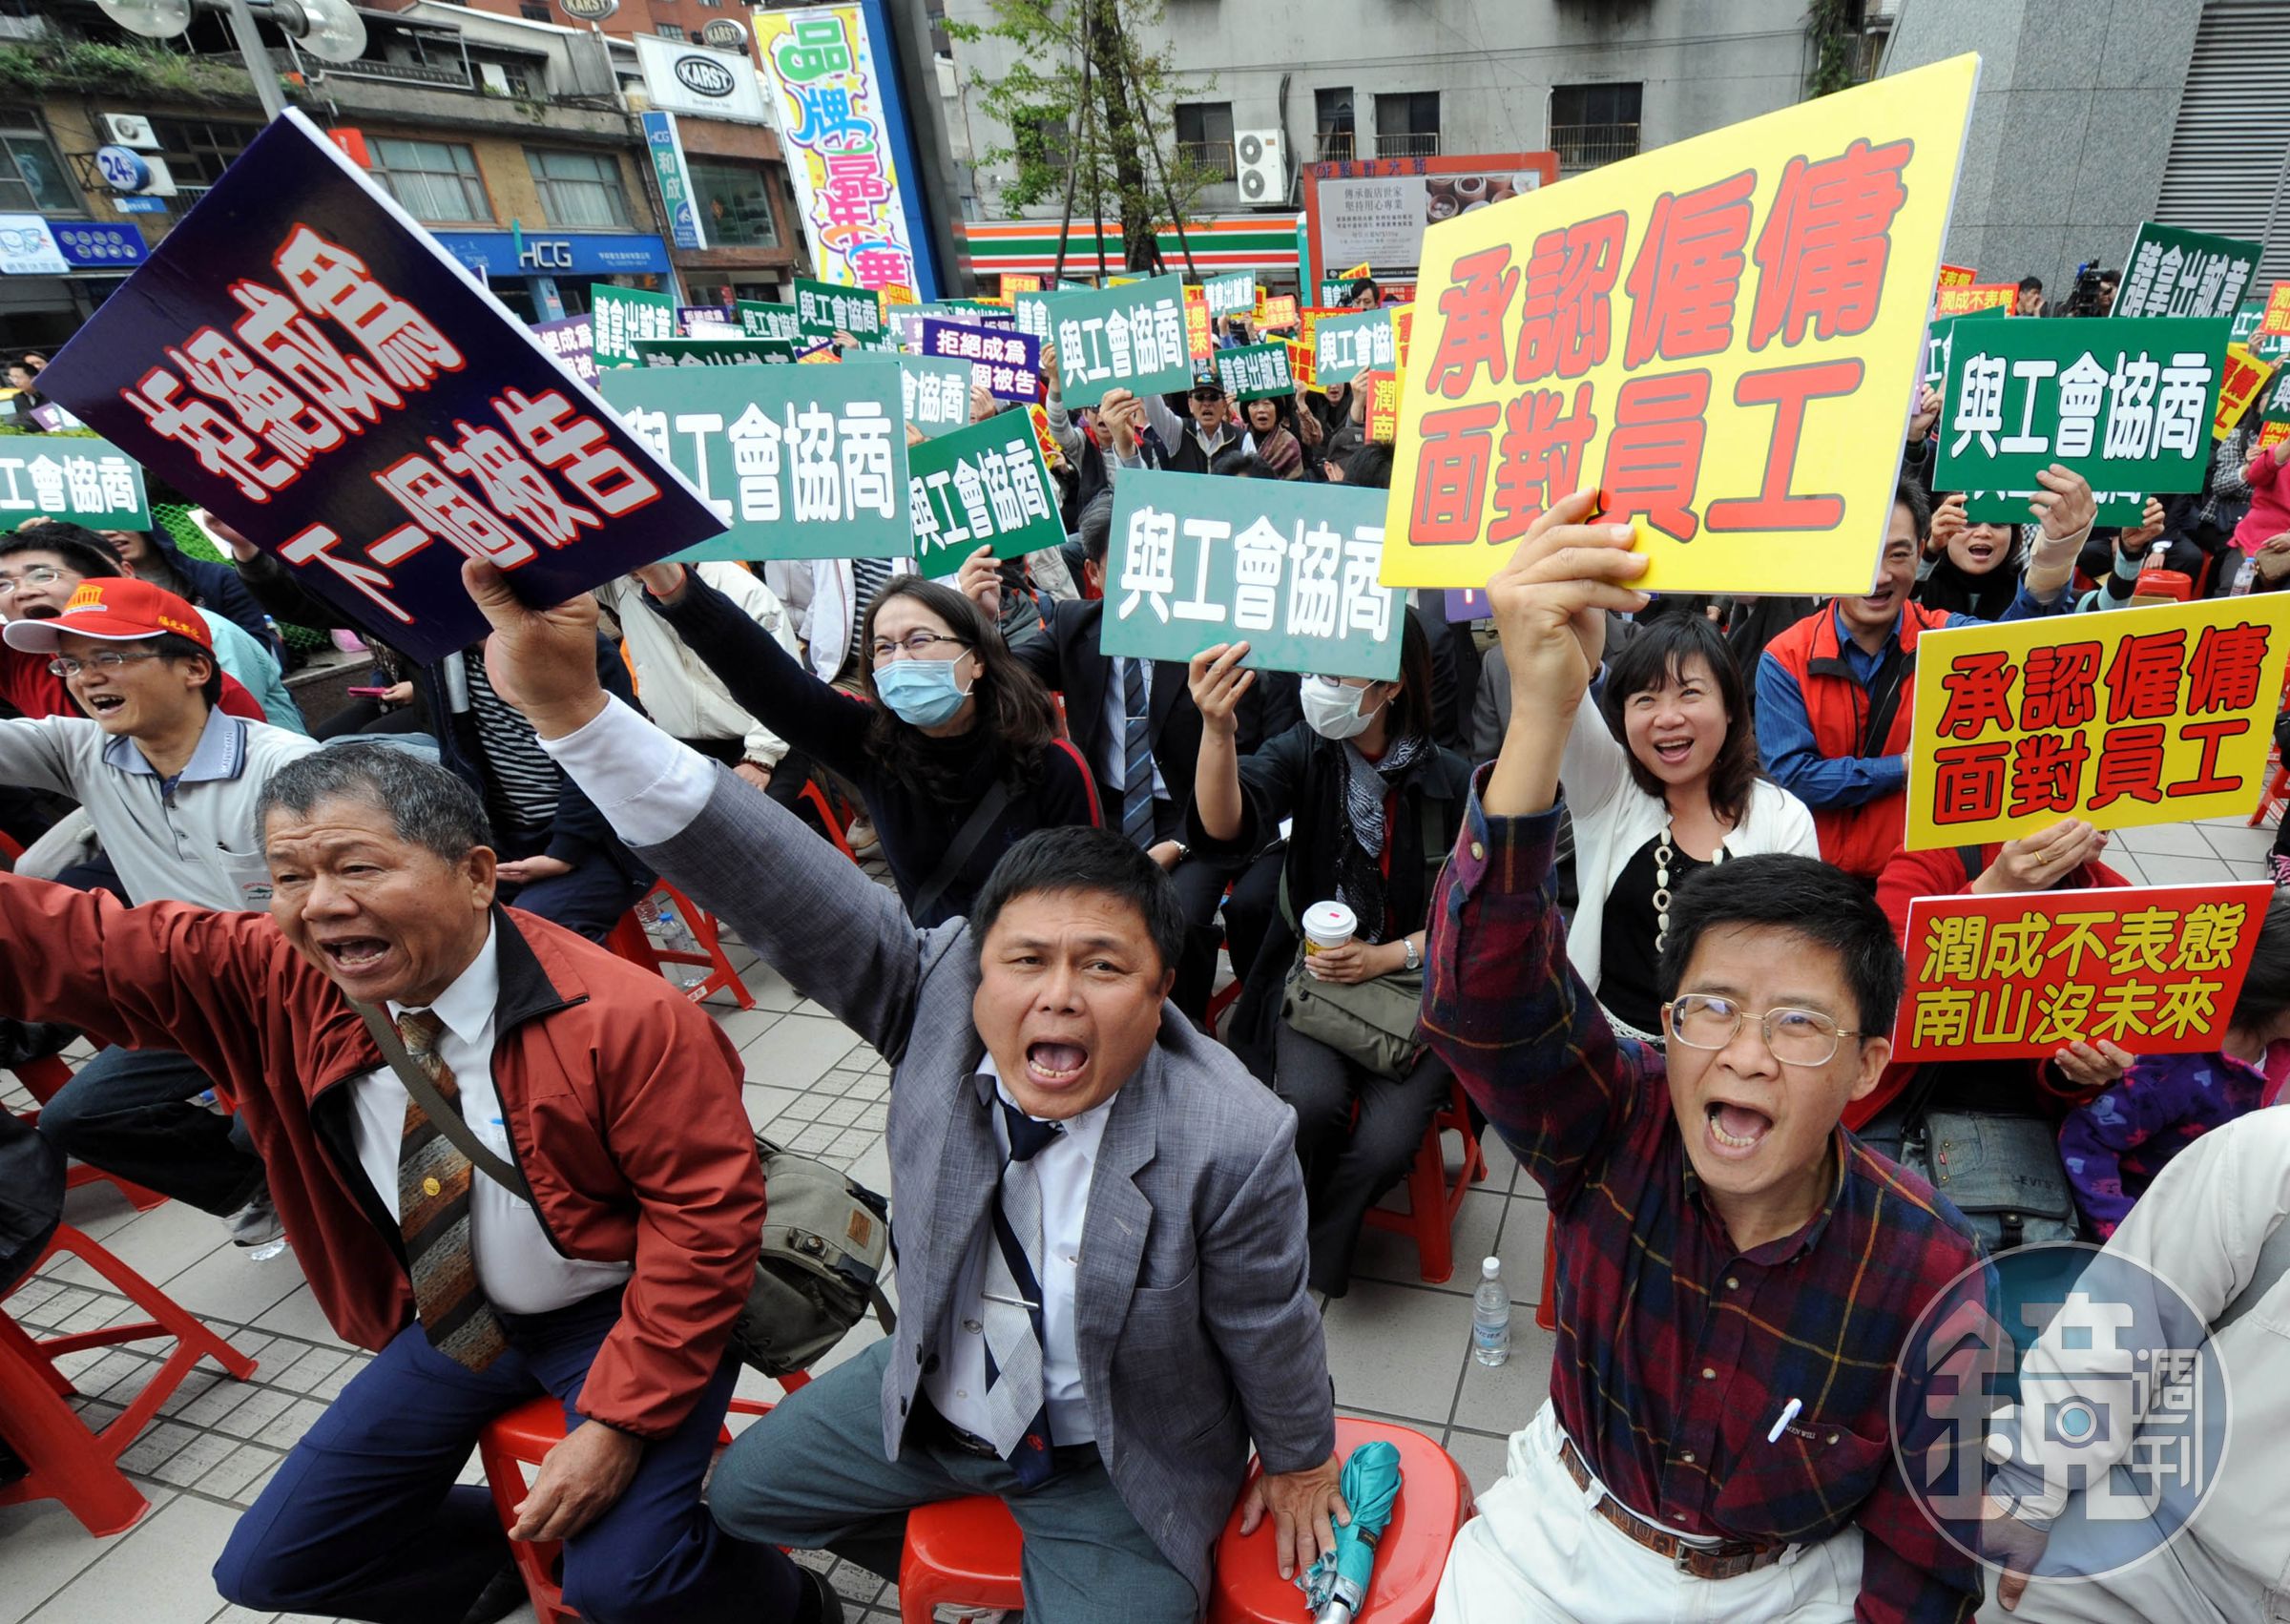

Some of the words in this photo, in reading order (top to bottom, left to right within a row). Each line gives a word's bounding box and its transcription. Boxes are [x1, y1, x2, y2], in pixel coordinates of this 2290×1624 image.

[680, 63, 730, 93] KARST
[706, 27, 738, 44] KARST
[650, 131, 670, 143] HCG
[657, 151, 682, 199] 和成
[778, 19, 909, 290] 品牌嘉年華
[519, 241, 572, 268] HCG
[1426, 138, 1914, 398] 承認僱傭
[800, 290, 878, 334] 與工會協商
[1059, 299, 1183, 387] 與工會協商
[1219, 349, 1291, 394] 請拿出誠意
[1950, 351, 2213, 460] 與工會協商
[1409, 359, 1864, 544] 面對員工
[278, 386, 662, 623] 下一個被告
[910, 438, 1050, 556] 與工會協商
[1117, 506, 1393, 642] 與工會協商
[1936, 621, 2271, 739] 承認僱傭
[1932, 718, 2250, 826] 面對員工
[1919, 901, 2246, 984] 潤成不表態
[1911, 975, 2224, 1050] 南山沒未來
